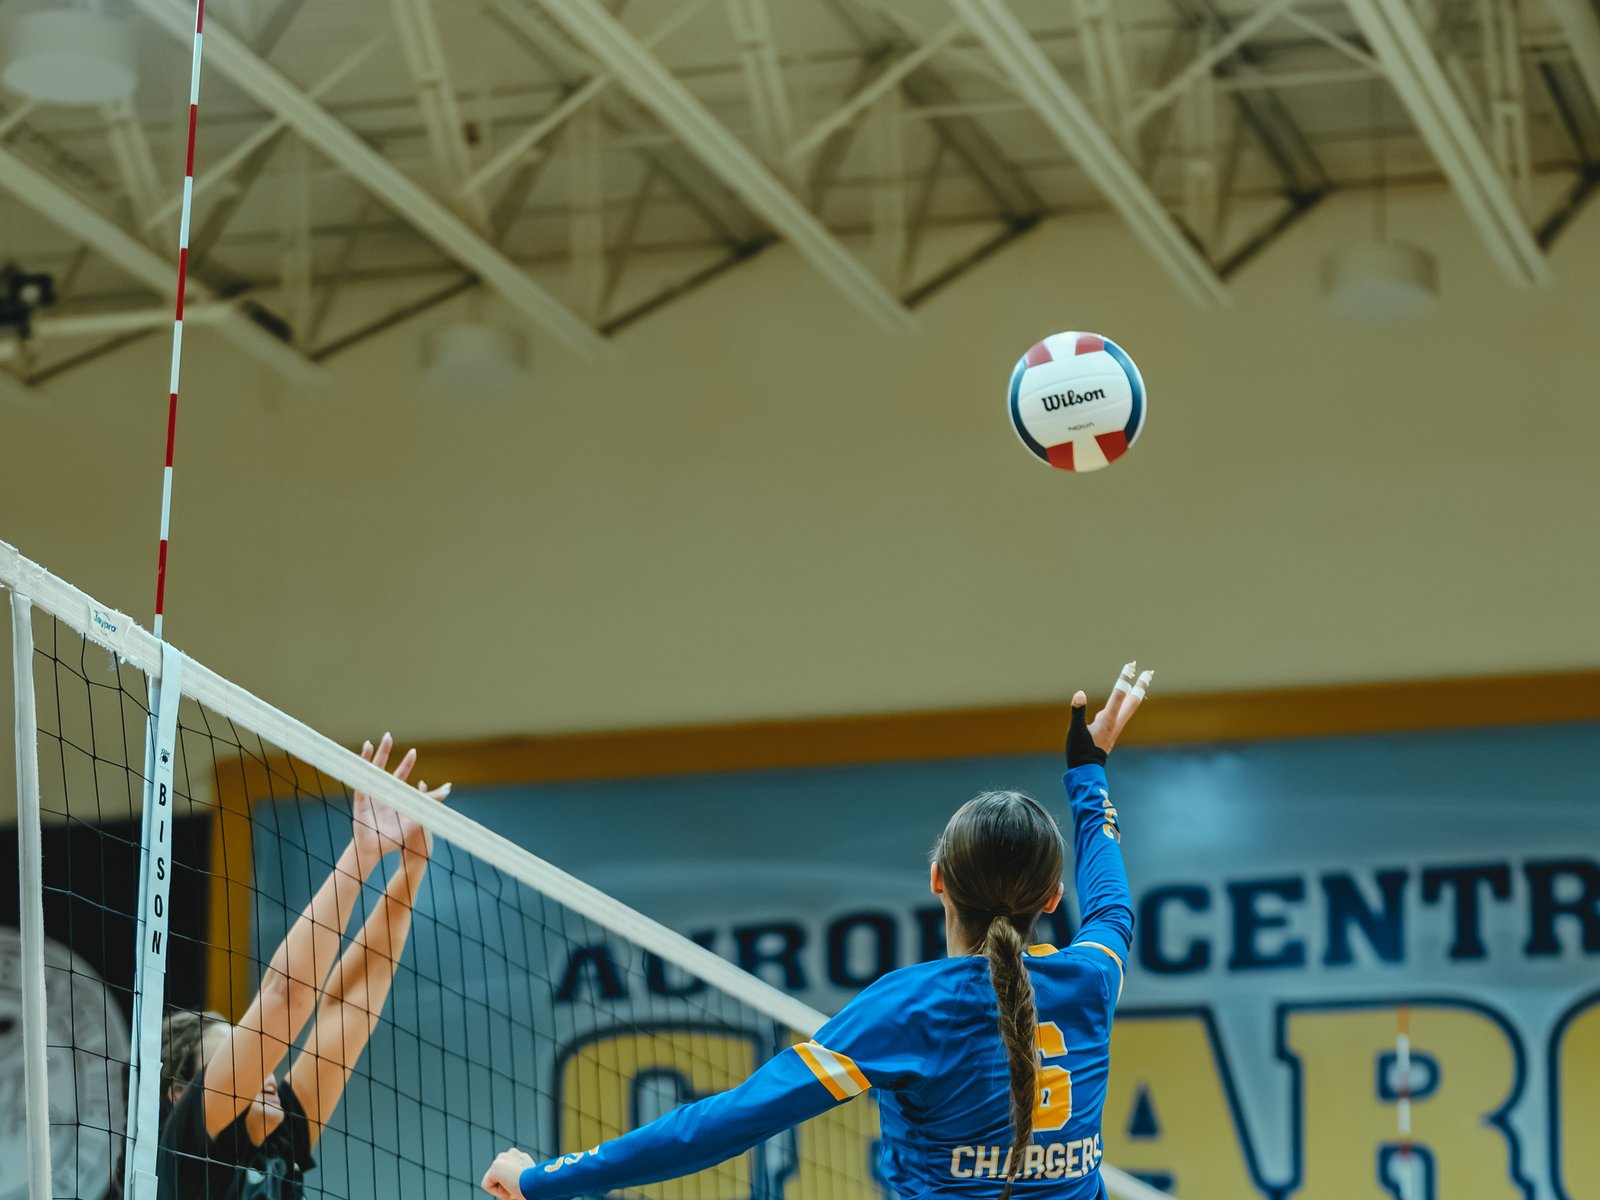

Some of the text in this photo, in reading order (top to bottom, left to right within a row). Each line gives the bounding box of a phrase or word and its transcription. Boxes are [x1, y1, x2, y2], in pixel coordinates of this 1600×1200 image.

[1041, 388, 1107, 412] Wilson
[93, 609, 118, 633] Jaypro
[151, 782, 167, 955] BISON
